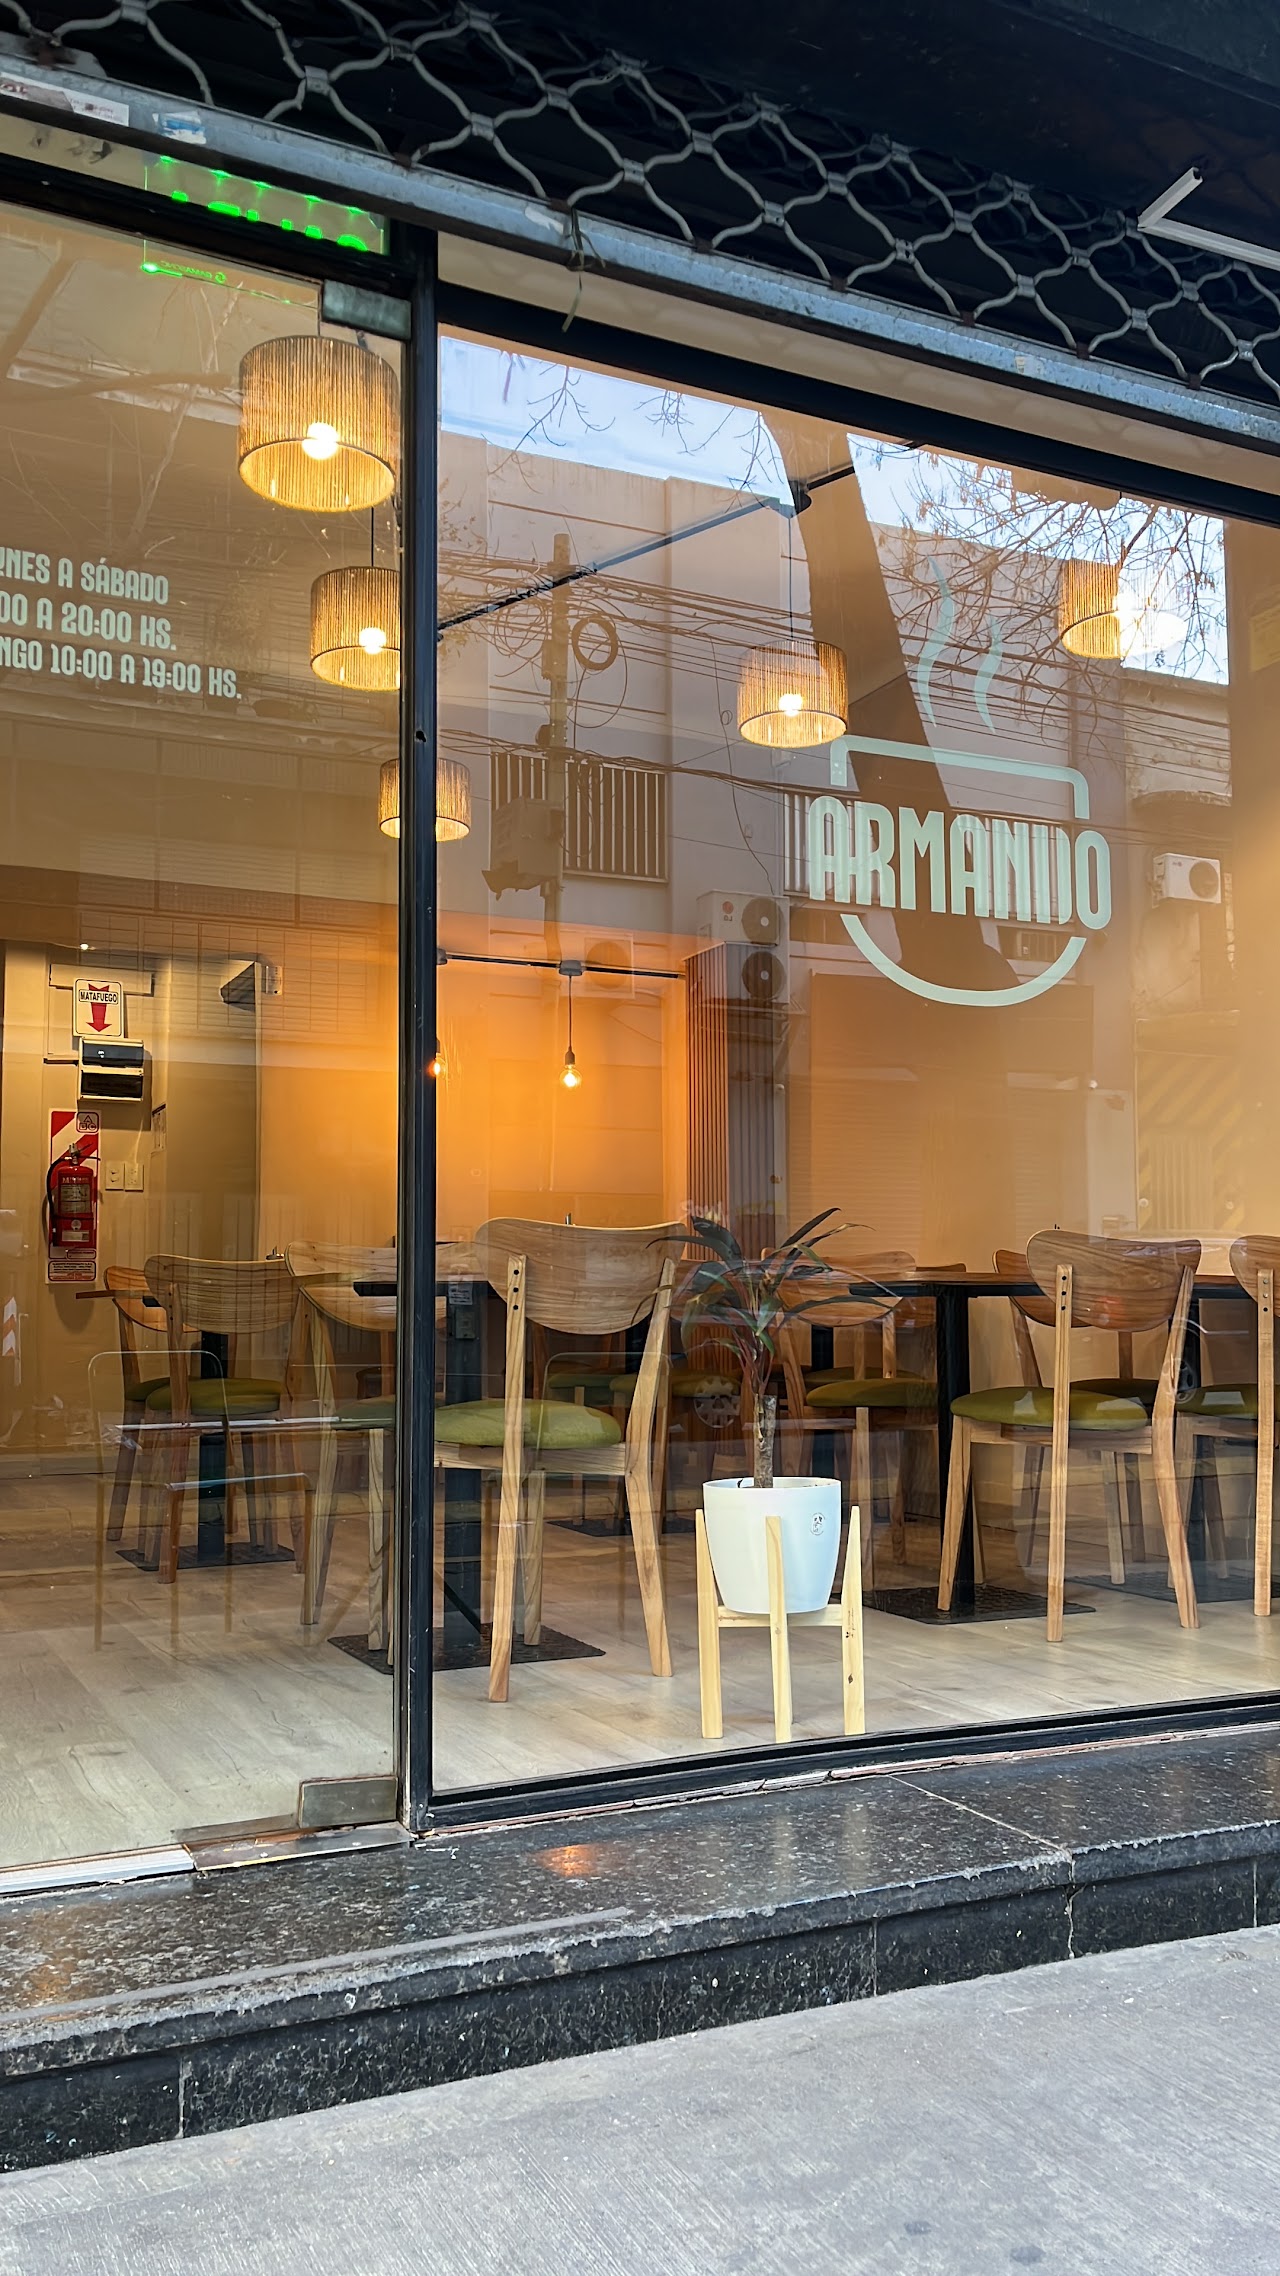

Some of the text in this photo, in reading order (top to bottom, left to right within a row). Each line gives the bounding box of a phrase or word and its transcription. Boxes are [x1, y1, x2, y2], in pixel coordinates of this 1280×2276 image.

[58, 558, 73, 589] A
[80, 557, 169, 605] SÁBADO
[37, 598, 53, 631] A
[61, 602, 132, 643] 20:00
[140, 615, 177, 651] HS.
[51, 643, 113, 681] 10:00
[120, 654, 135, 684] A
[142, 657, 201, 693] 19:00
[208, 667, 242, 699] HS.
[808, 795, 1112, 930] ARMANDO
[80, 991, 118, 1003] MATAFUEGO
